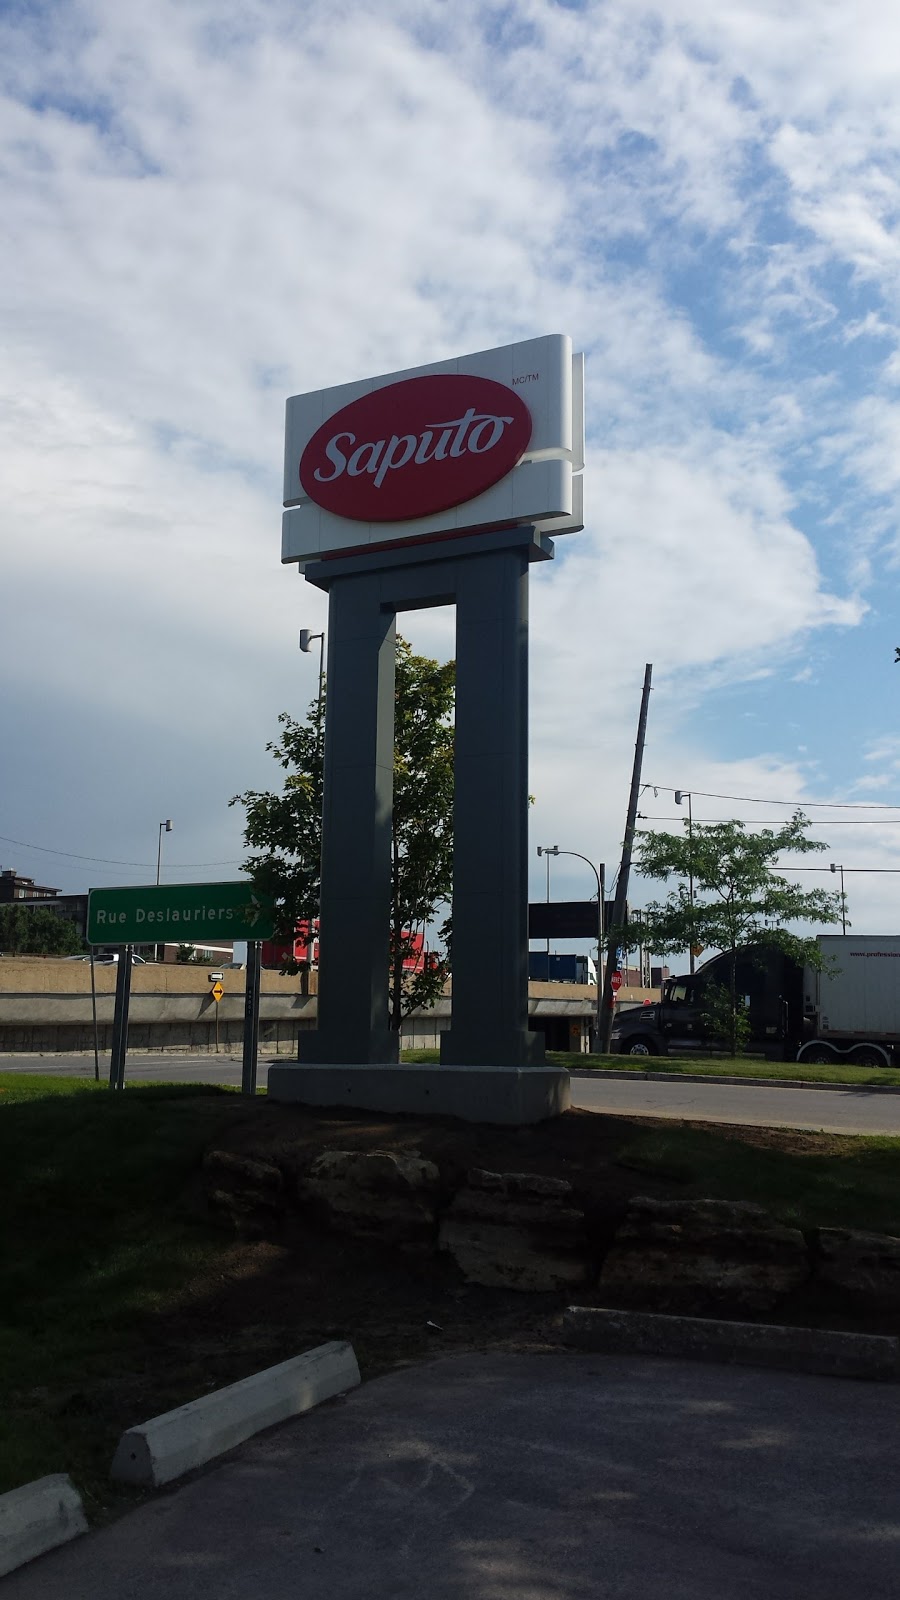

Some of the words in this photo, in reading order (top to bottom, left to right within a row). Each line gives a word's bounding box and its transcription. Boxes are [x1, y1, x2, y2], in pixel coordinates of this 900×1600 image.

[512, 373, 539, 386] MC/TM
[313, 408, 514, 488] Saputo
[96, 909, 127, 924] Rue
[135, 906, 234, 923] Deslauriers
